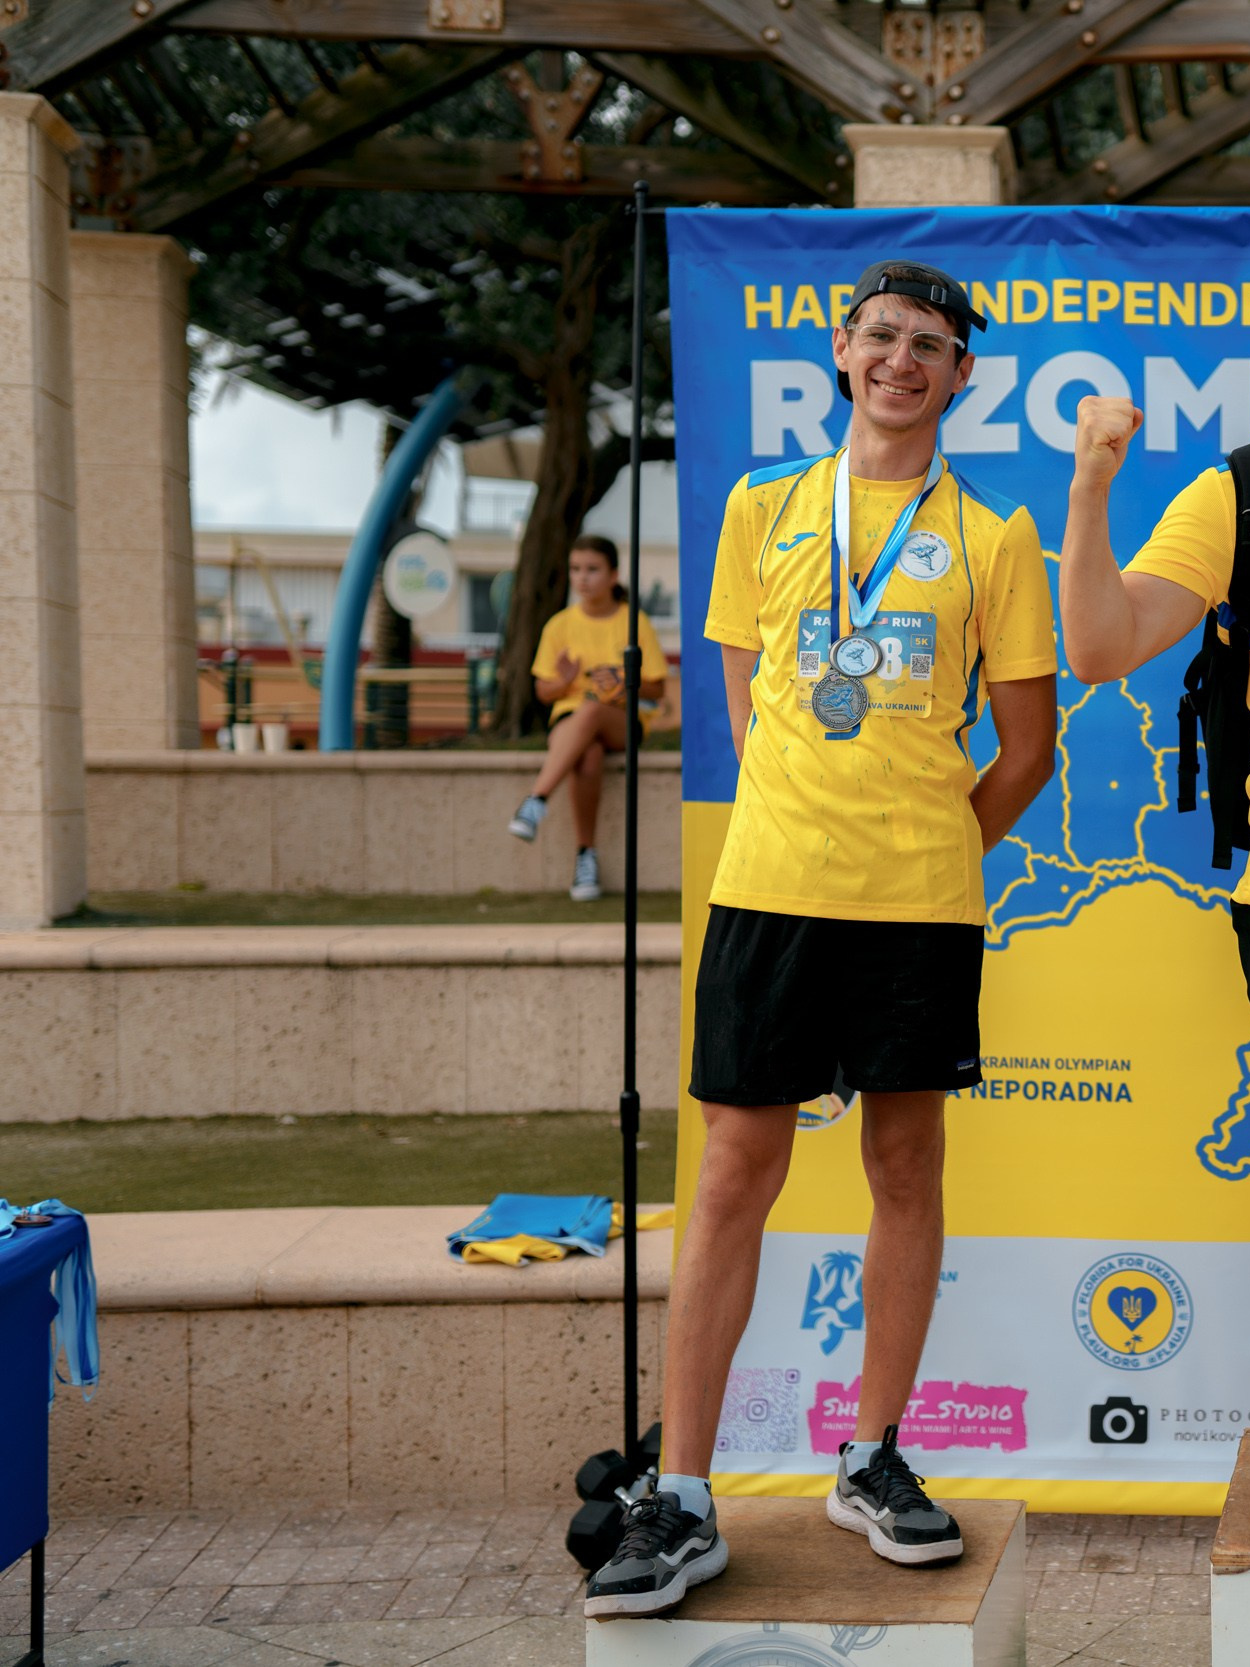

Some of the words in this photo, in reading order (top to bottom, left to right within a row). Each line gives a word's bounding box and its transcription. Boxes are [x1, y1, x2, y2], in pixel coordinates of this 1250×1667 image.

[744, 284, 854, 329] HAP
[892, 617, 921, 628] RUN
[915, 638, 928, 646] 5K
[980, 1056, 1050, 1070] KRAINIAN
[1055, 1058, 1131, 1072] OLYMPIAN
[971, 1080, 1133, 1103] NEPORADNA
[1079, 1261, 1116, 1305] FLORIDA
[1118, 1257, 1144, 1267] FOR
[1146, 1261, 1186, 1307] UKRAINE
[1079, 1324, 1140, 1367] FL4UA.ORG
